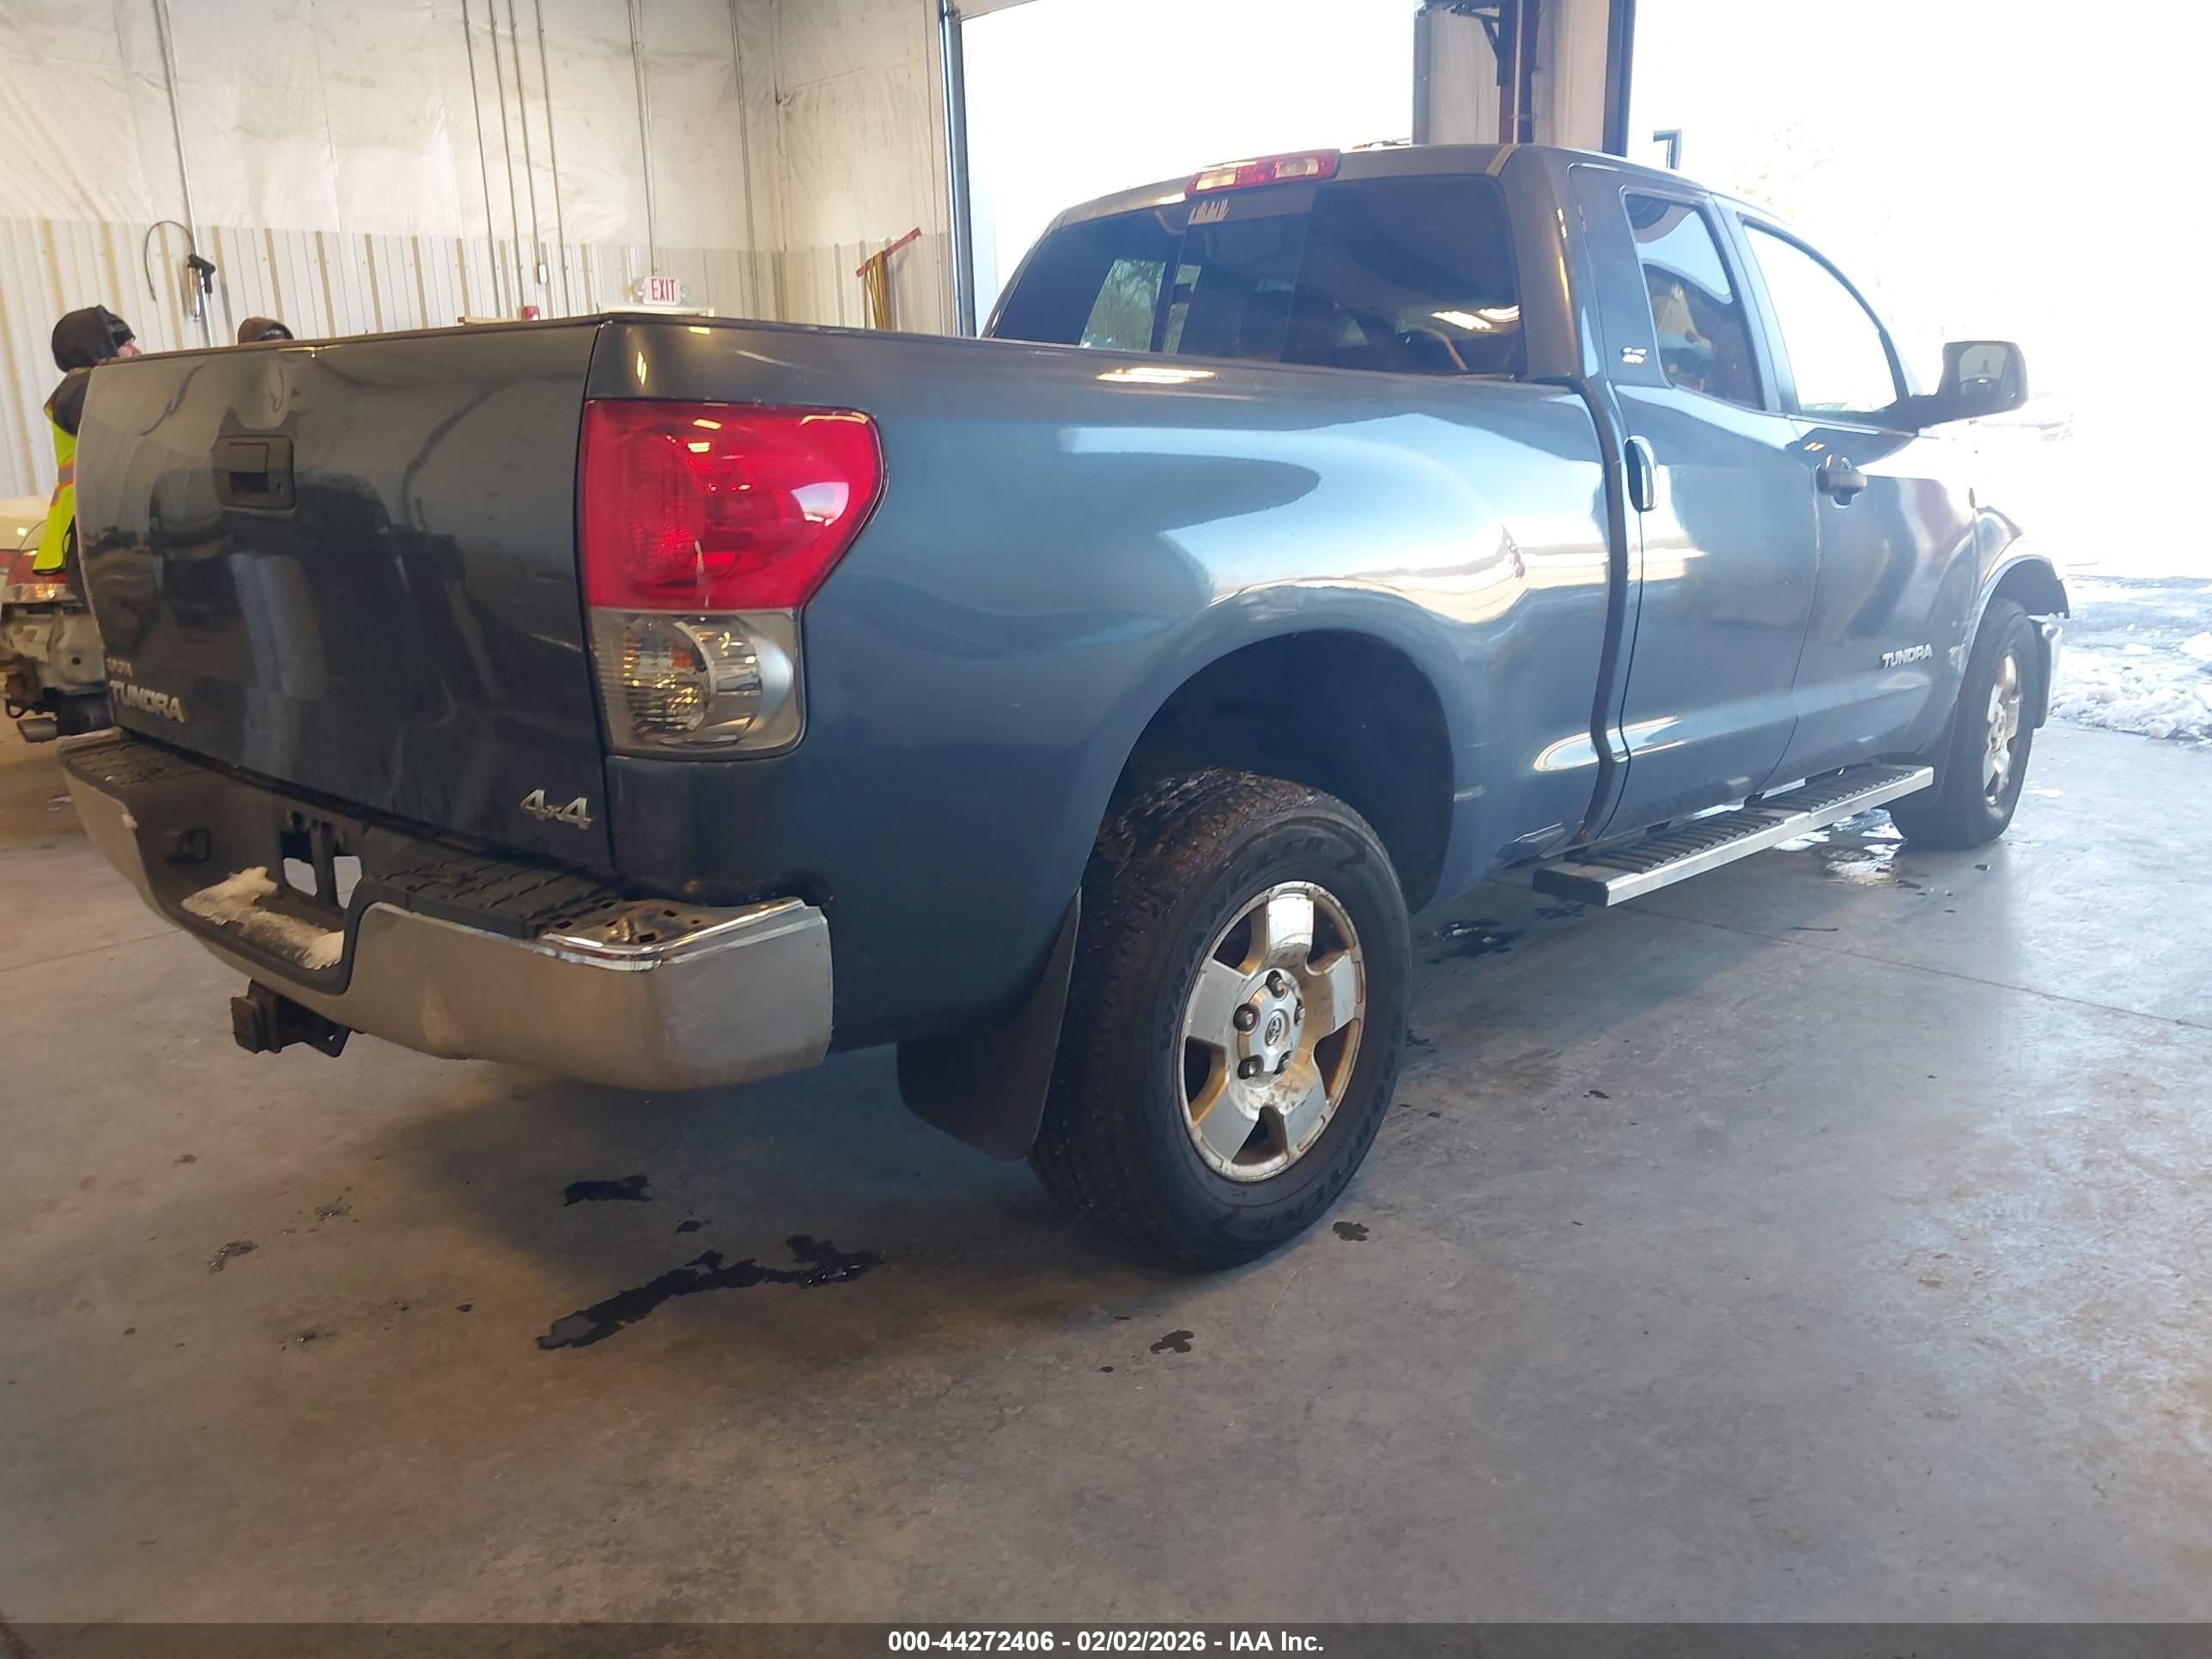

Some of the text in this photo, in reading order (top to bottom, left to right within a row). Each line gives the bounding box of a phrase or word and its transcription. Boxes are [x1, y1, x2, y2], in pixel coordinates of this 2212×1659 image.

[651, 278, 675, 302] EXIT
[1881, 643, 1933, 669] TUNDRA
[109, 679, 185, 723] TUNDRA
[520, 788, 592, 830] 4x4
